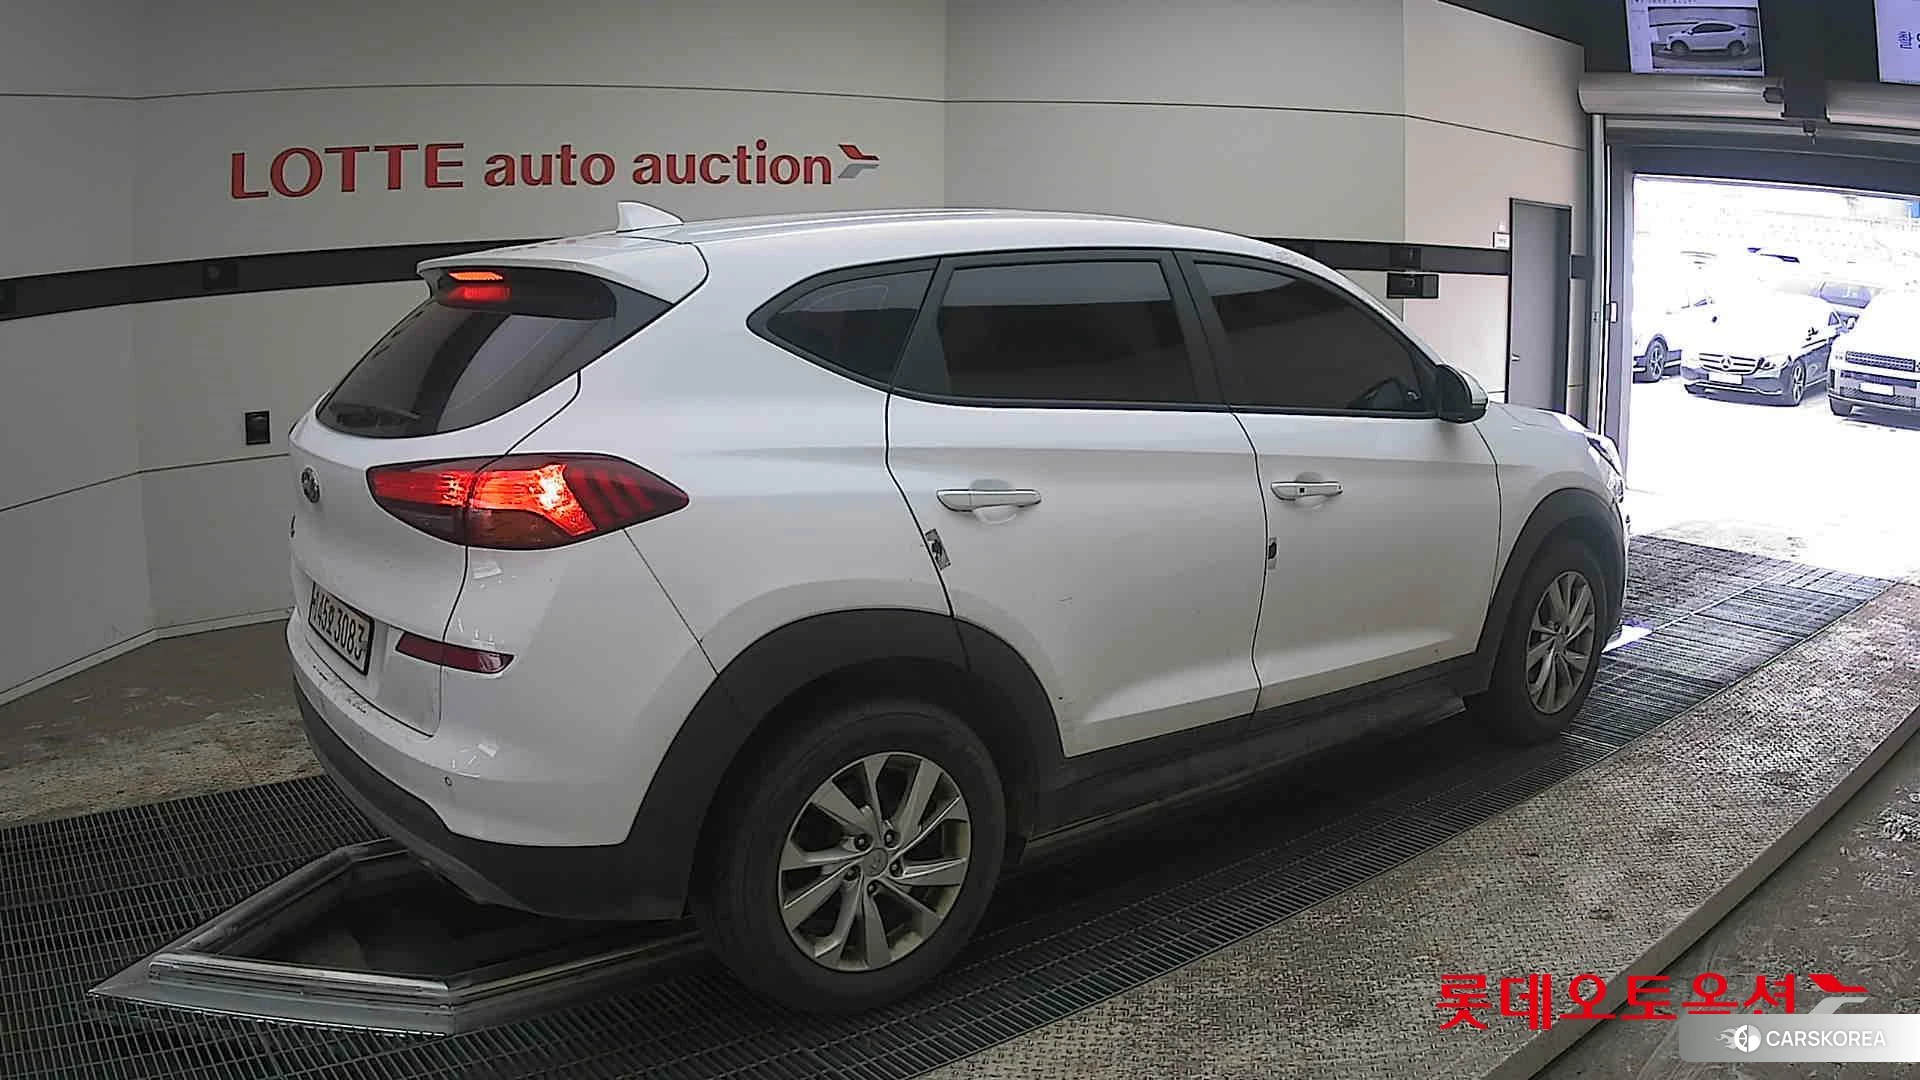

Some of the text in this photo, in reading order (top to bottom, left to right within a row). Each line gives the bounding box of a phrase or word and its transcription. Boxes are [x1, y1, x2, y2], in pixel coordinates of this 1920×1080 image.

[231, 140, 832, 199] LOTTE auto auction
[335, 608, 365, 660] 3083
